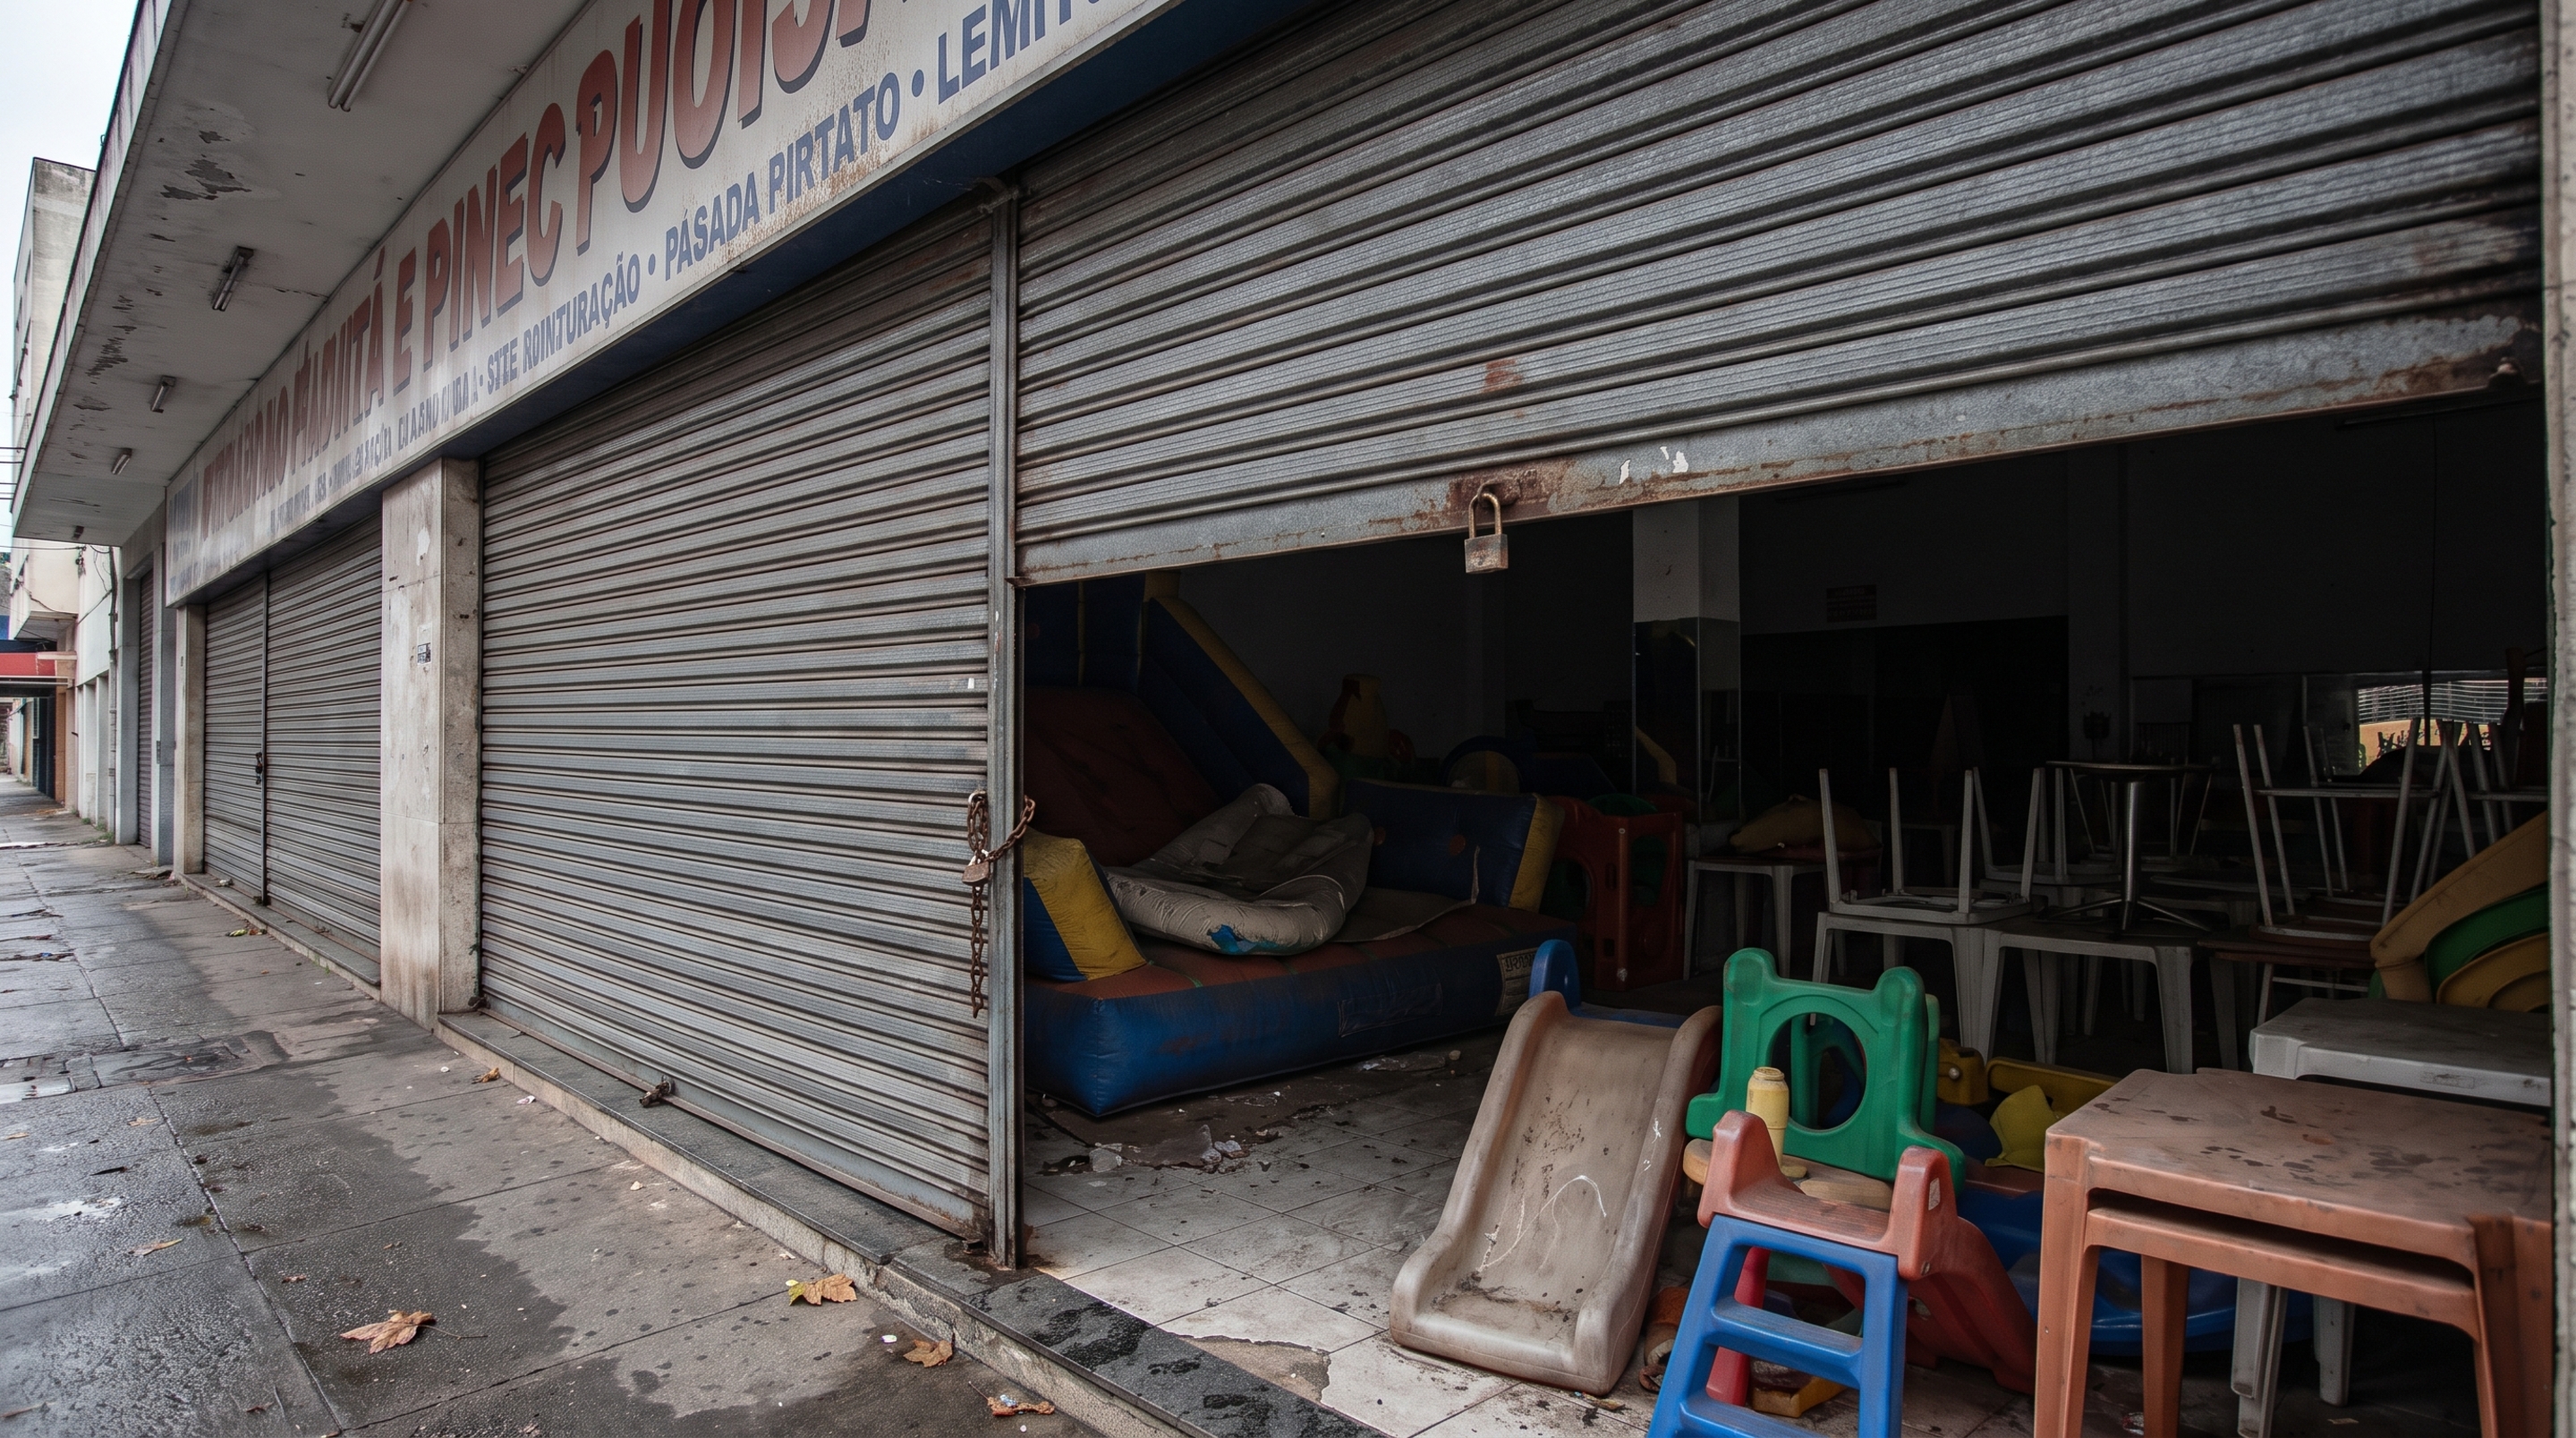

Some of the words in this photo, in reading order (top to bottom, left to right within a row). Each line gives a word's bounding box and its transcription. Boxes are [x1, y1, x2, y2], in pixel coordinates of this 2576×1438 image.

[393, 246, 416, 397] E
[423, 102, 566, 374] PINEC
[665, 171, 761, 282] PÁSADA
[769, 72, 900, 215] PIRTATO
